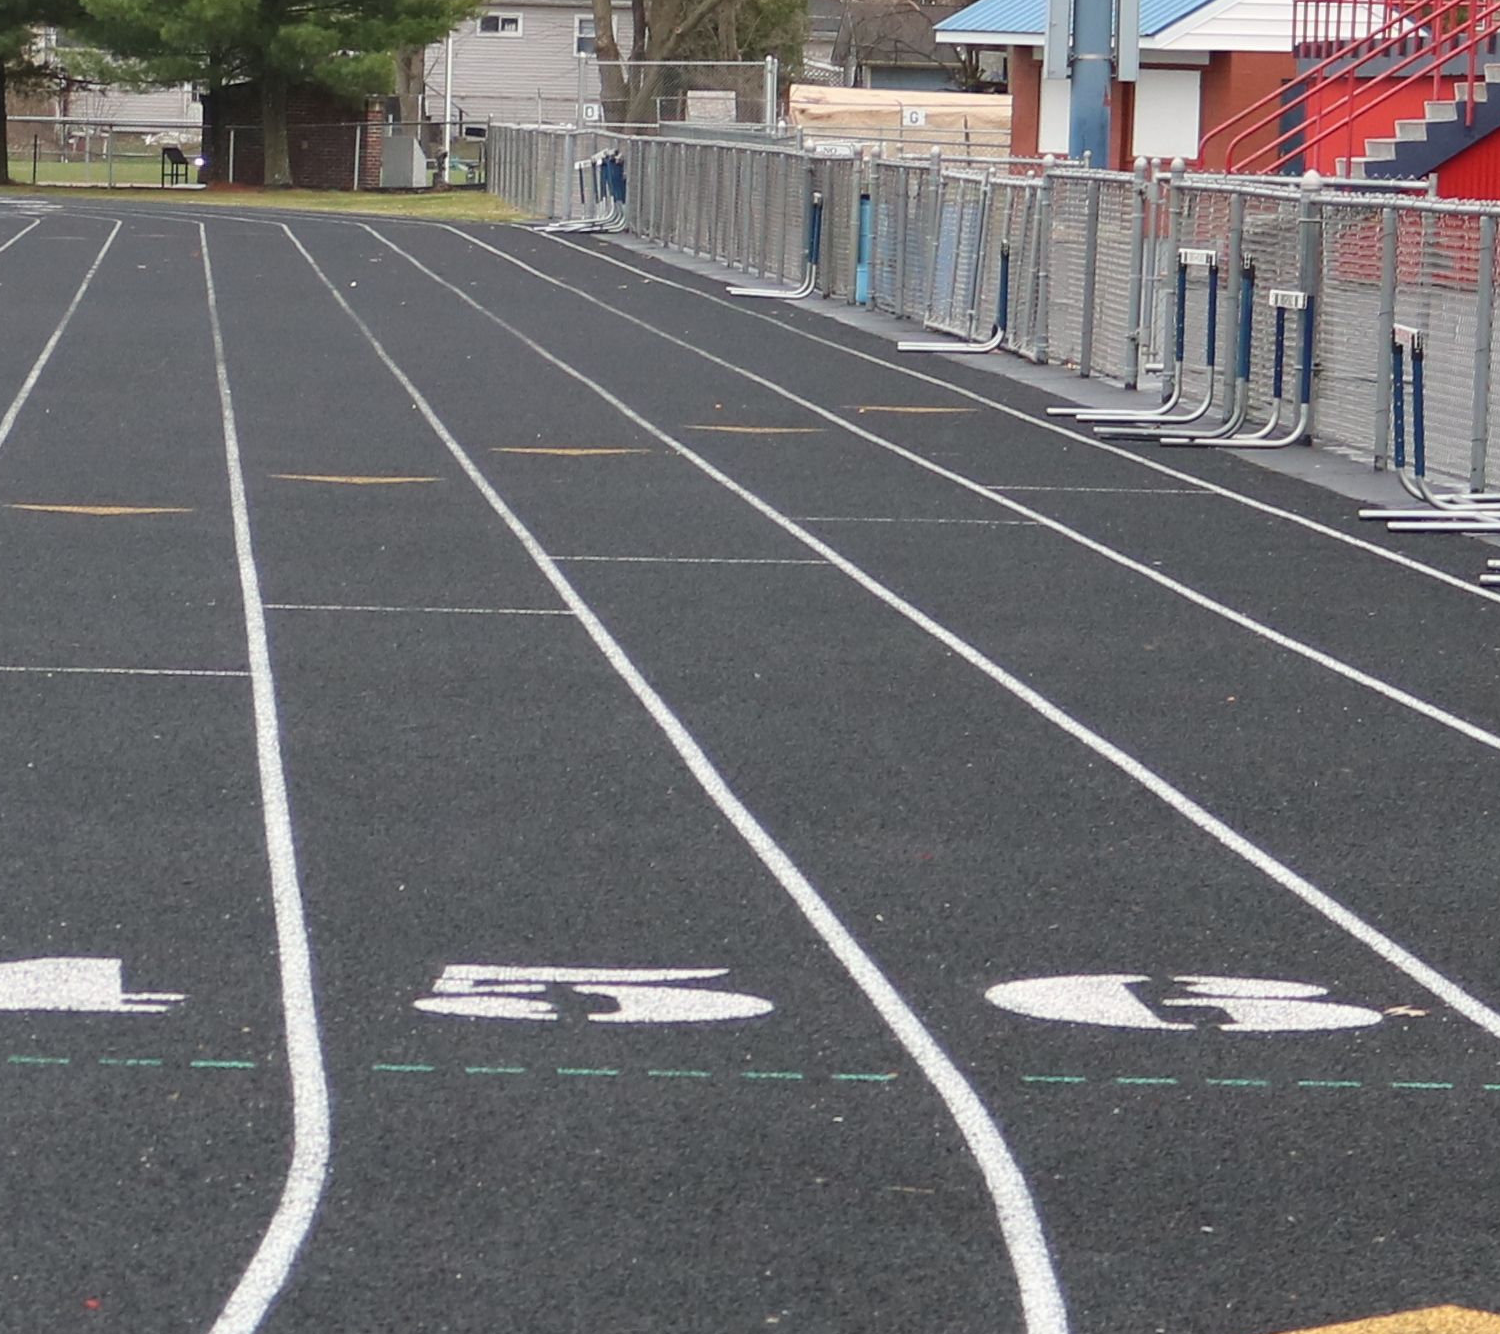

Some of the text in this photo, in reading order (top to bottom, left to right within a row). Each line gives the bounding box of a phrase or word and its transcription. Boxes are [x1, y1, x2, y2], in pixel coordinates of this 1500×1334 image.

[909, 111, 919, 125] G
[413, 965, 773, 1022] 5
[985, 975, 1383, 1031] 6
